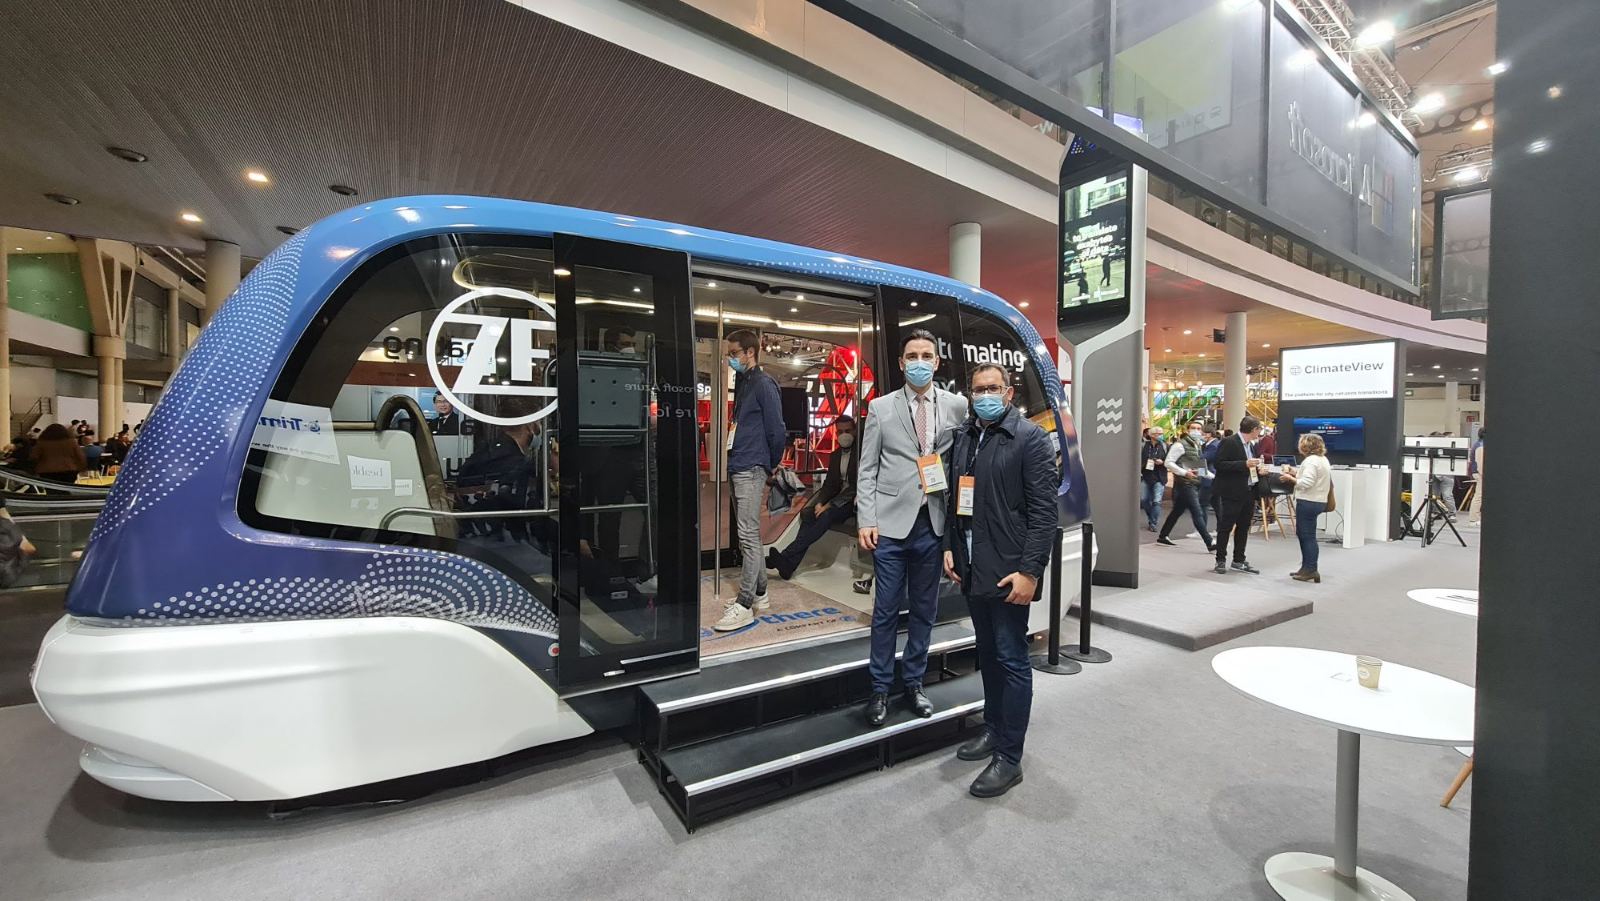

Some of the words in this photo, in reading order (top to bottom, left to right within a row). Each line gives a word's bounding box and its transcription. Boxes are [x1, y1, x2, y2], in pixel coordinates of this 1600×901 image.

[443, 313, 557, 396] ZF
[937, 338, 1025, 372] tmating
[1304, 362, 1384, 374] ClimateView
